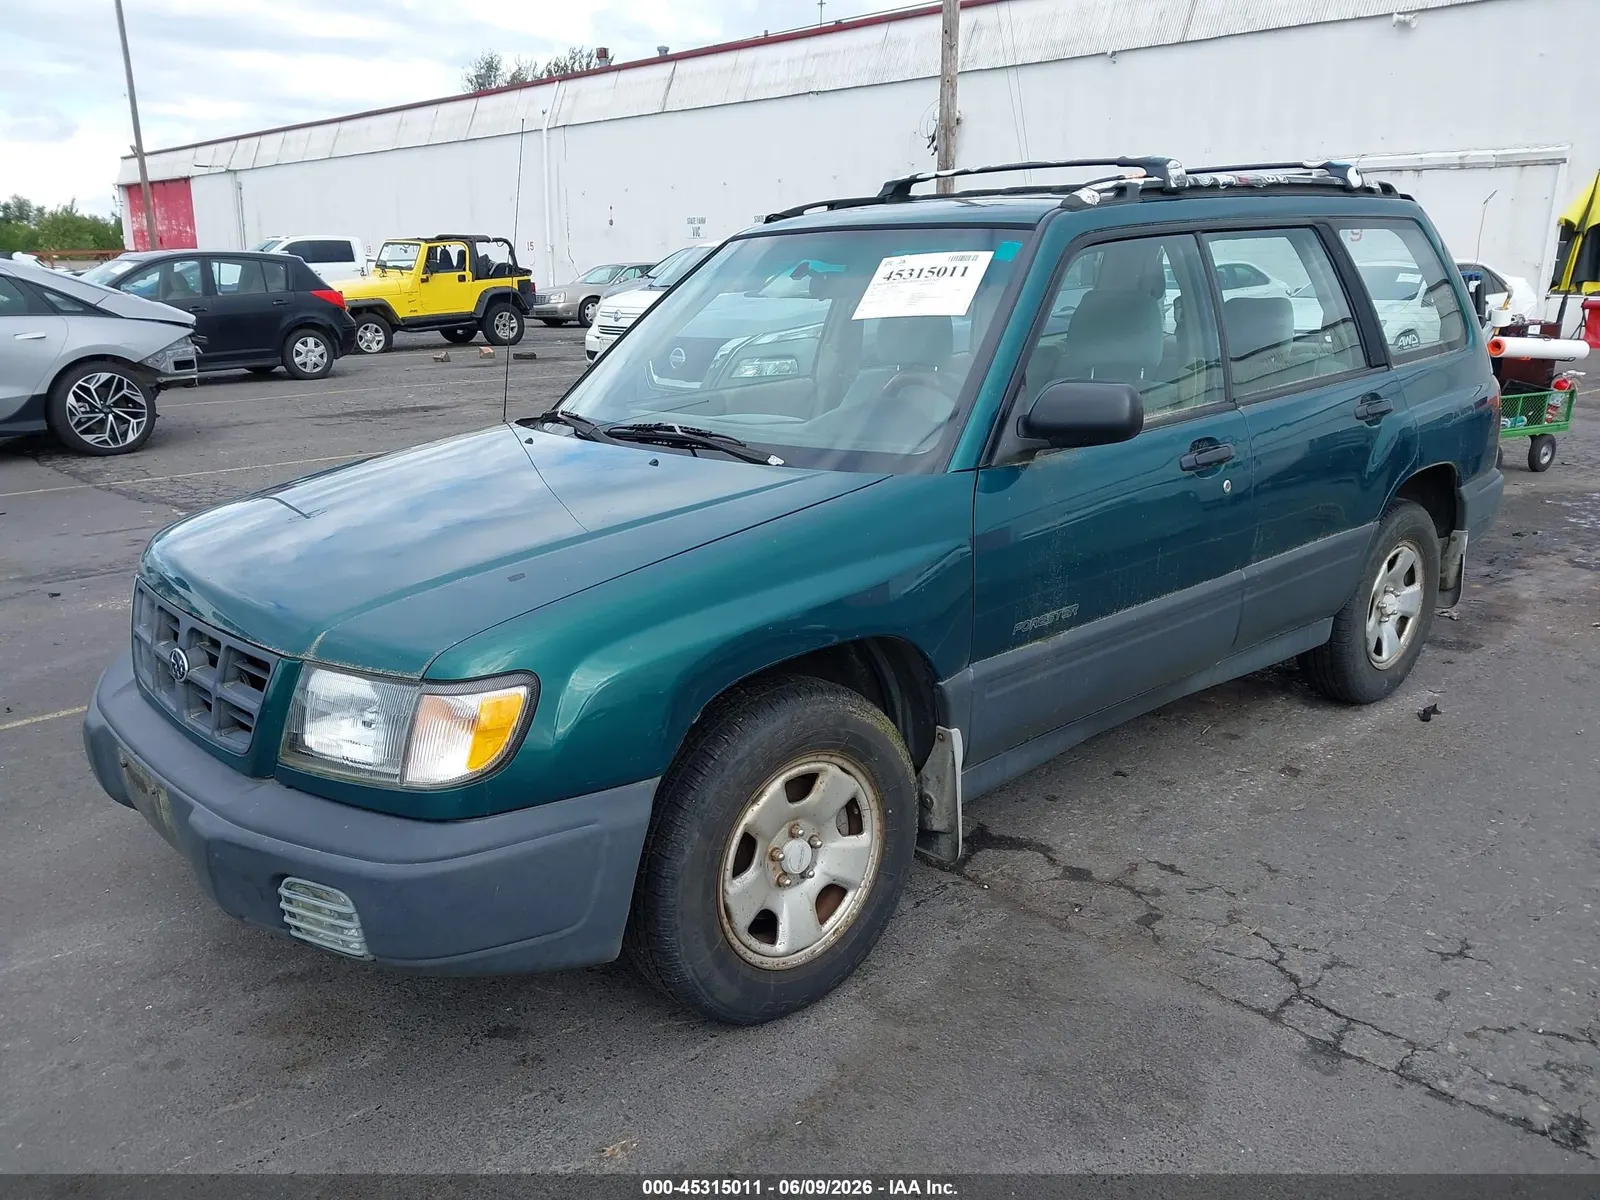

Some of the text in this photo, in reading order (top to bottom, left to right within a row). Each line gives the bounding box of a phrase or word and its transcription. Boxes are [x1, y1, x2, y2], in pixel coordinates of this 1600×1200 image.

[527, 241, 535, 251] 15
[882, 265, 969, 281] 45315011
[1398, 333, 1419, 347] AWD
[1012, 603, 1079, 635] FORESTER
